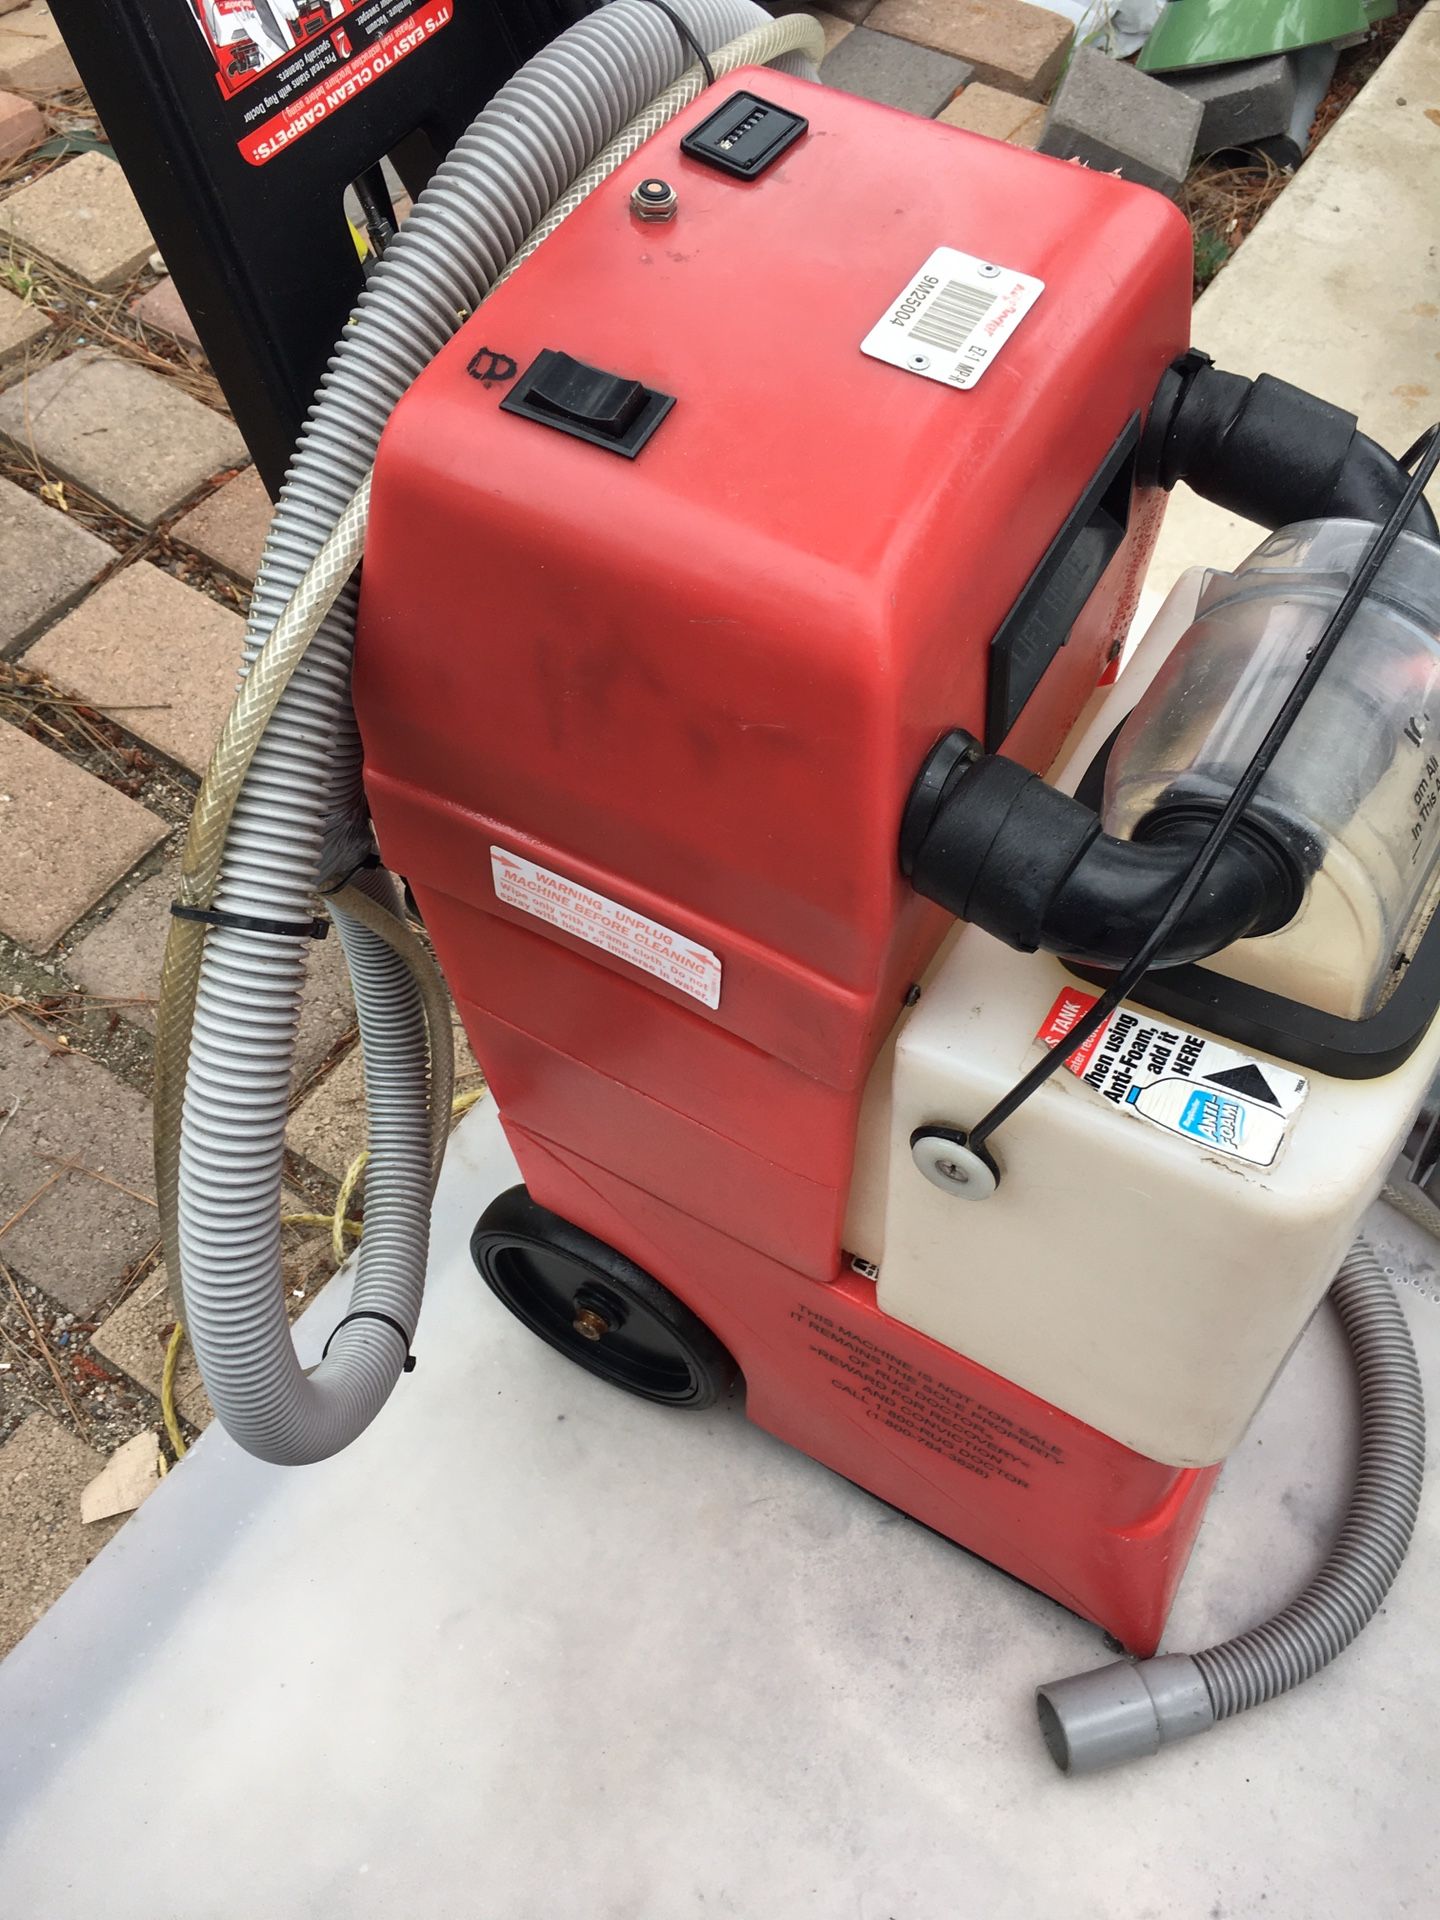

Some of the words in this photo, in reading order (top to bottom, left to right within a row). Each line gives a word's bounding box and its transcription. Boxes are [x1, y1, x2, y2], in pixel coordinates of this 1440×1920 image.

[365, 14, 389, 35] Vacuum
[425, 7, 449, 33] IT'S
[304, 40, 331, 64] specialty
[337, 31, 351, 59] 2
[393, 26, 426, 59] EASY
[276, 58, 305, 82] cleaners.
[309, 51, 337, 77] Pre-treat
[373, 53, 392, 73] TO
[278, 84, 293, 99] with
[292, 70, 311, 89] stains
[304, 86, 326, 105] before
[326, 67, 372, 109] CLEAN
[243, 102, 266, 123] Doctor
[264, 94, 280, 108] Rug
[252, 102, 326, 160] CARPETS:
[889, 274, 940, 329] 9M25004
[1419, 792, 1437, 822] This
[504, 870, 570, 906] MACHINE
[575, 903, 631, 937] BEFORE
[634, 932, 706, 975] CLEANING
[535, 872, 602, 910] WARNING
[615, 910, 673, 945] UNPLUG
[500, 882, 528, 899] Wipe
[532, 899, 555, 914] only
[560, 910, 584, 927] with
[598, 930, 629, 949] damp
[633, 947, 666, 969] cloth.
[671, 965, 685, 978] Do
[689, 976, 708, 992] not
[500, 892, 530, 911] spray
[534, 908, 558, 924] with
[562, 920, 588, 938] hose
[592, 936, 603, 945] or
[607, 942, 656, 971] immerse
[660, 969, 670, 980] in
[674, 977, 708, 1001] water.
[1051, 1000, 1081, 1035] TANK
[1105, 1013, 1139, 1053] using
[1158, 1030, 1180, 1046] it
[1069, 1050, 1086, 1074] ater
[1103, 1027, 1158, 1104] Anti-Foam,
[1147, 1044, 1172, 1076] add
[1171, 1035, 1206, 1077] HERE
[790, 1311, 804, 1322] IT
[808, 1321, 882, 1364] REMAINS
[886, 1363, 917, 1384] THE
[922, 1384, 965, 1411] SOLE
[971, 1411, 1064, 1465] PROPERTY
[798, 1303, 833, 1328] THIS
[838, 1326, 913, 1371] MACHINE
[918, 1370, 933, 1383] IS
[938, 1382, 974, 1403] NOT
[977, 1404, 1014, 1427] FOR
[1018, 1427, 1062, 1454] SALE
[848, 1355, 870, 1368] OF
[875, 1369, 910, 1392] RUG
[891, 1389, 926, 1411] FOR
[831, 1379, 870, 1405] CALL
[959, 1449, 1029, 1488] DOCTOR
[862, 1386, 896, 1407] AND
[900, 1406, 1002, 1464] CONVICTION
